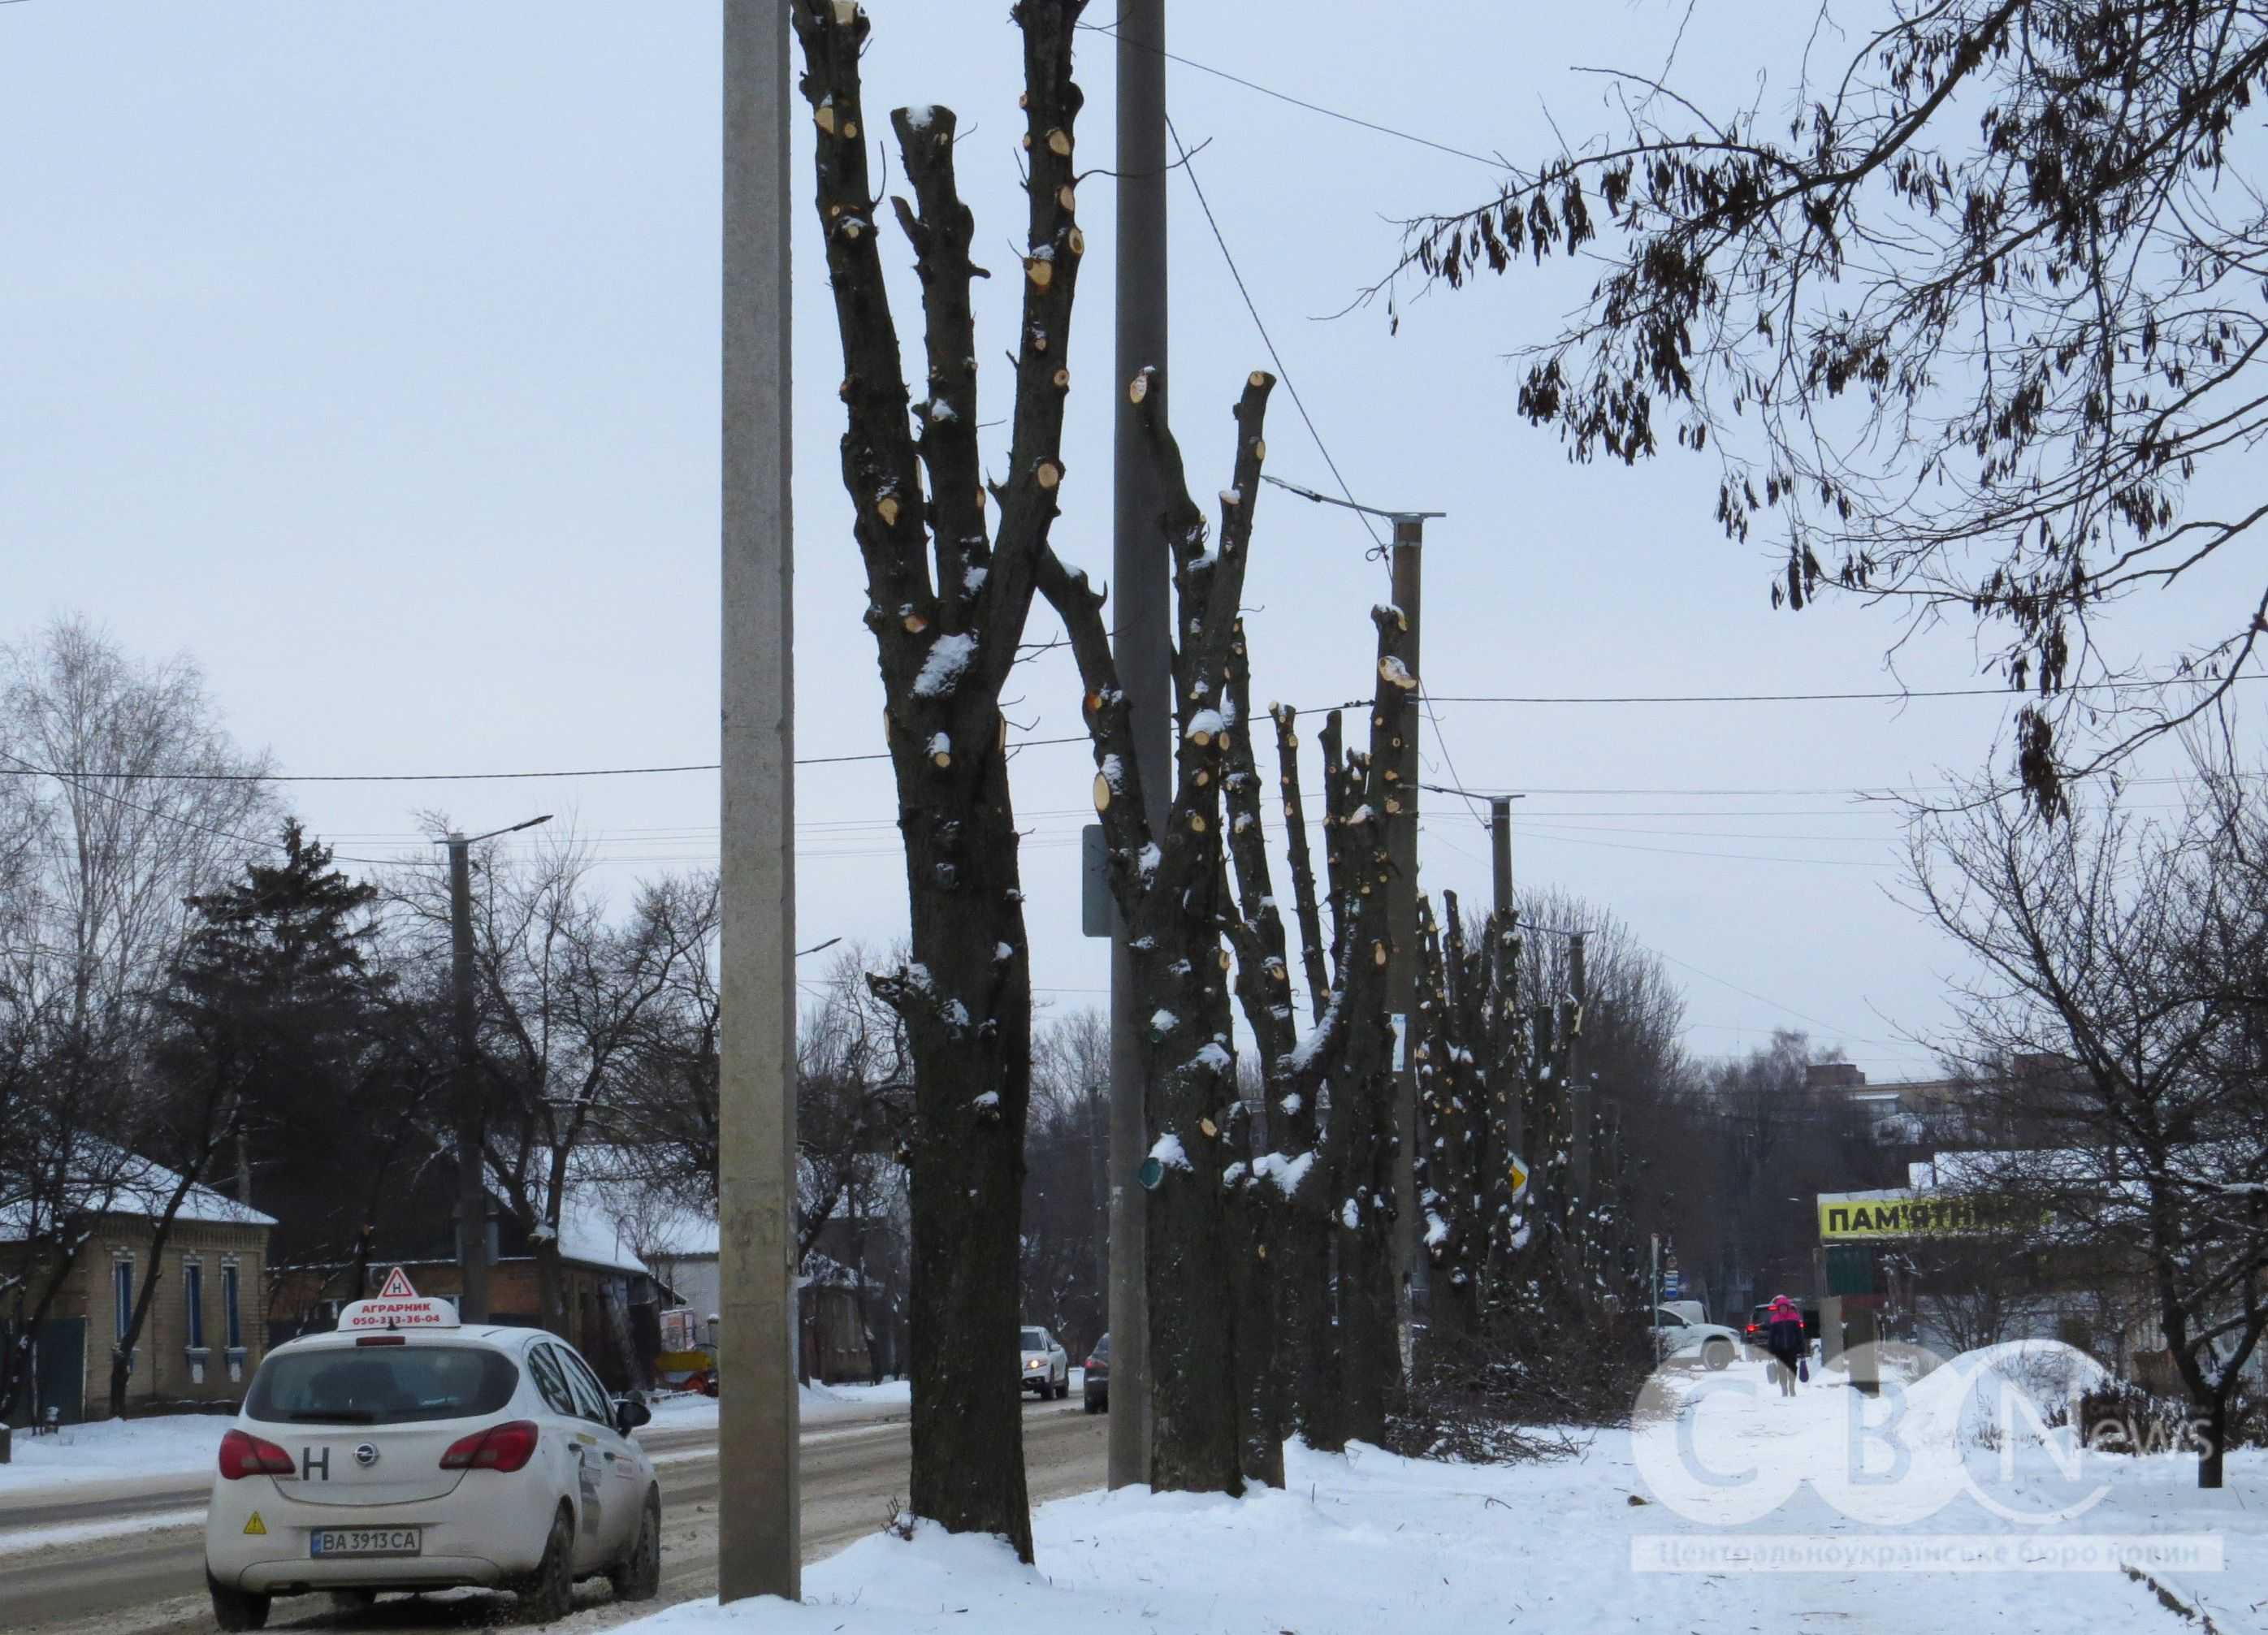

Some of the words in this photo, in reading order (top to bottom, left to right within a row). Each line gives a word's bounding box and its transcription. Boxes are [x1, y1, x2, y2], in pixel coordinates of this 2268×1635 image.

[361, 1303, 431, 1313] АГРАРНИК
[302, 1446, 330, 1481] Н
[323, 1533, 347, 1551] BA
[351, 1533, 388, 1549] 3913
[391, 1532, 416, 1548] CA
